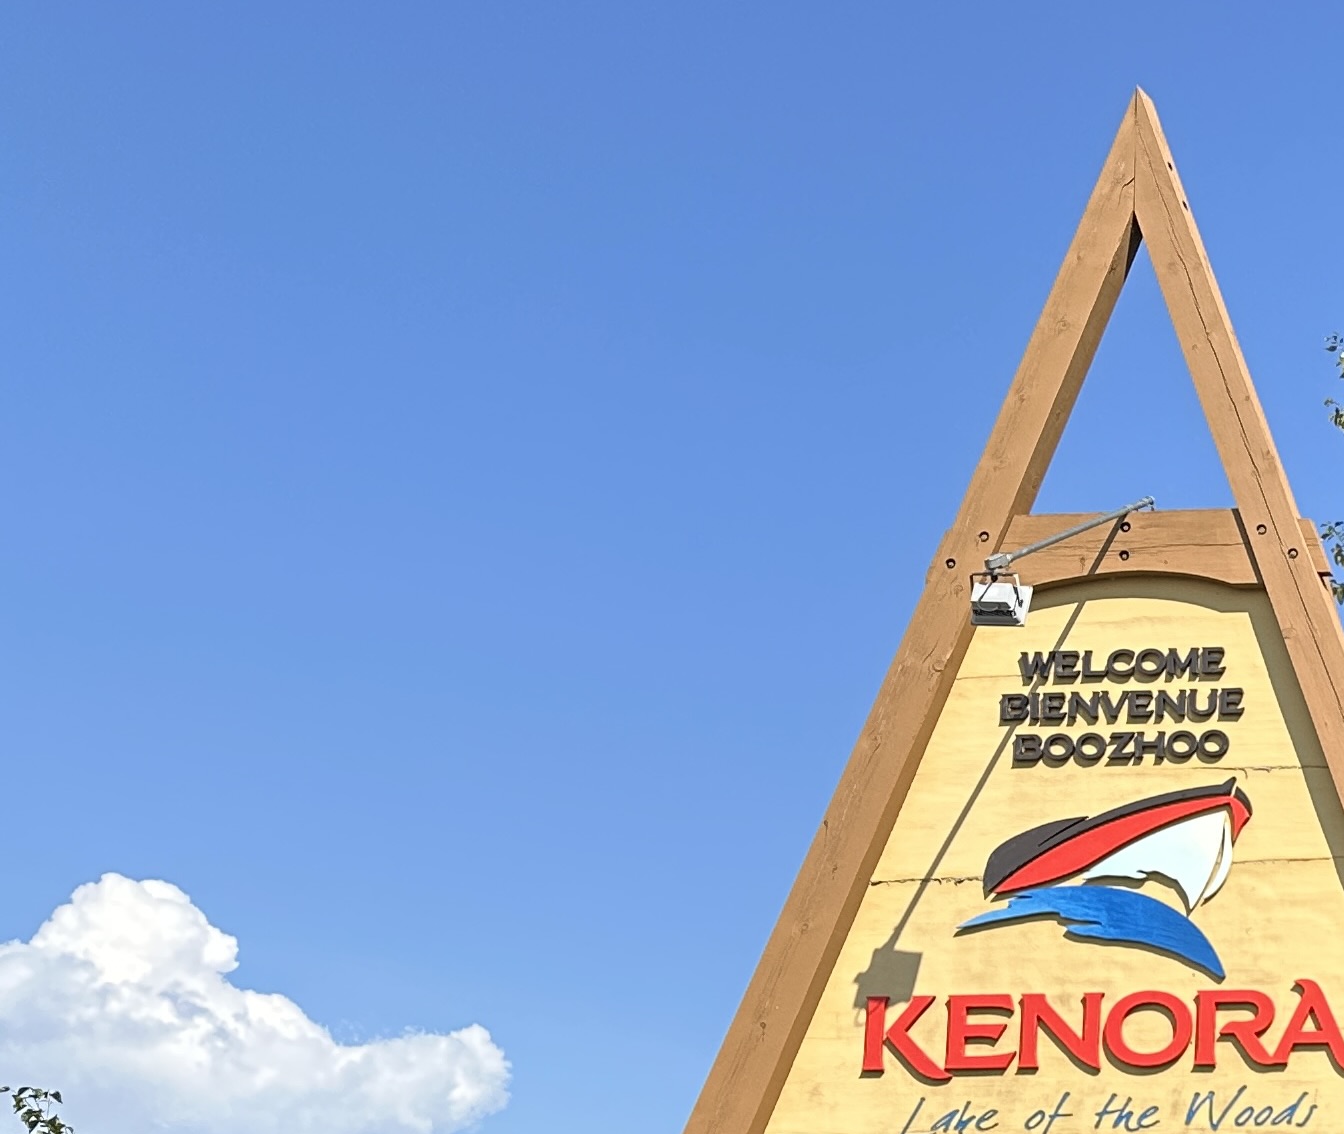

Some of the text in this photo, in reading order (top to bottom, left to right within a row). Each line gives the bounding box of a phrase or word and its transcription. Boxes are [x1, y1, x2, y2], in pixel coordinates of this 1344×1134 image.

[1018, 646, 1226, 686] WELCOME
[999, 687, 1245, 728] BIENVENUE
[1011, 729, 1230, 768] BOOZHOO
[1094, 1093, 1161, 1132] the
[1184, 1085, 1318, 1131] Woods
